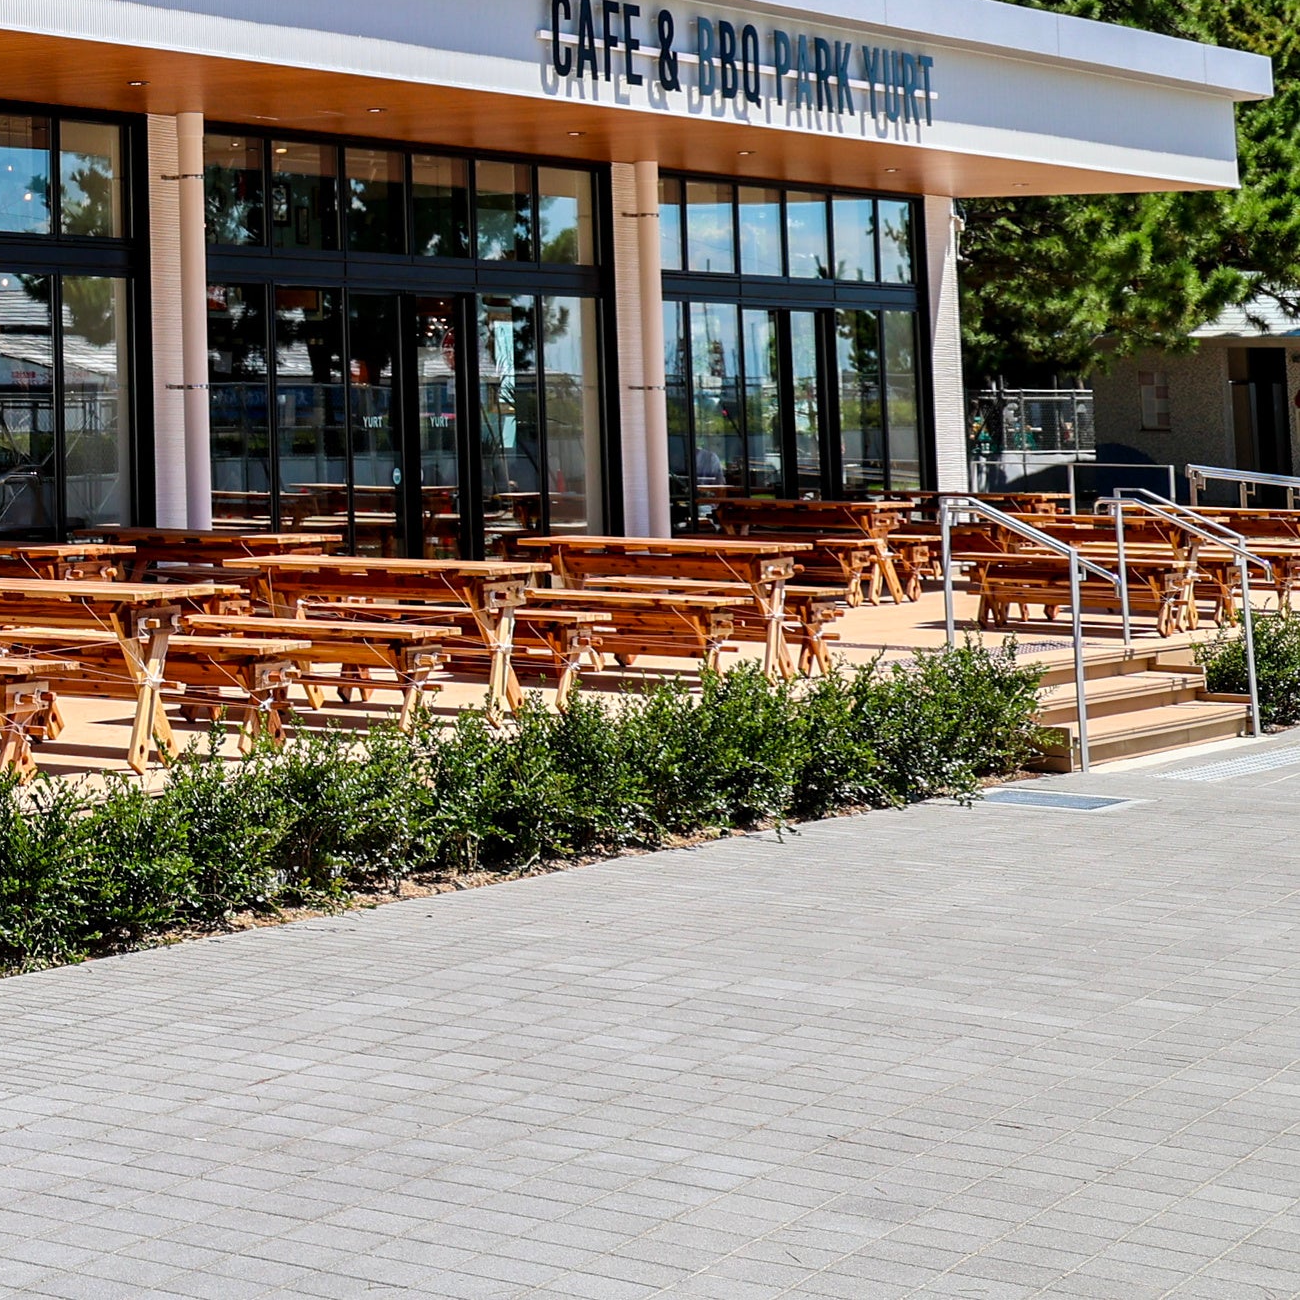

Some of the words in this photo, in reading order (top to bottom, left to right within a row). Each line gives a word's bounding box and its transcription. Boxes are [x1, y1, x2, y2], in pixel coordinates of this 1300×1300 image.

[657, 9, 682, 92] &
[697, 16, 761, 109] BBQ
[773, 29, 855, 116] PARK
[862, 45, 934, 126] YURT
[363, 416, 383, 428] YURT
[430, 416, 449, 428] YURT
